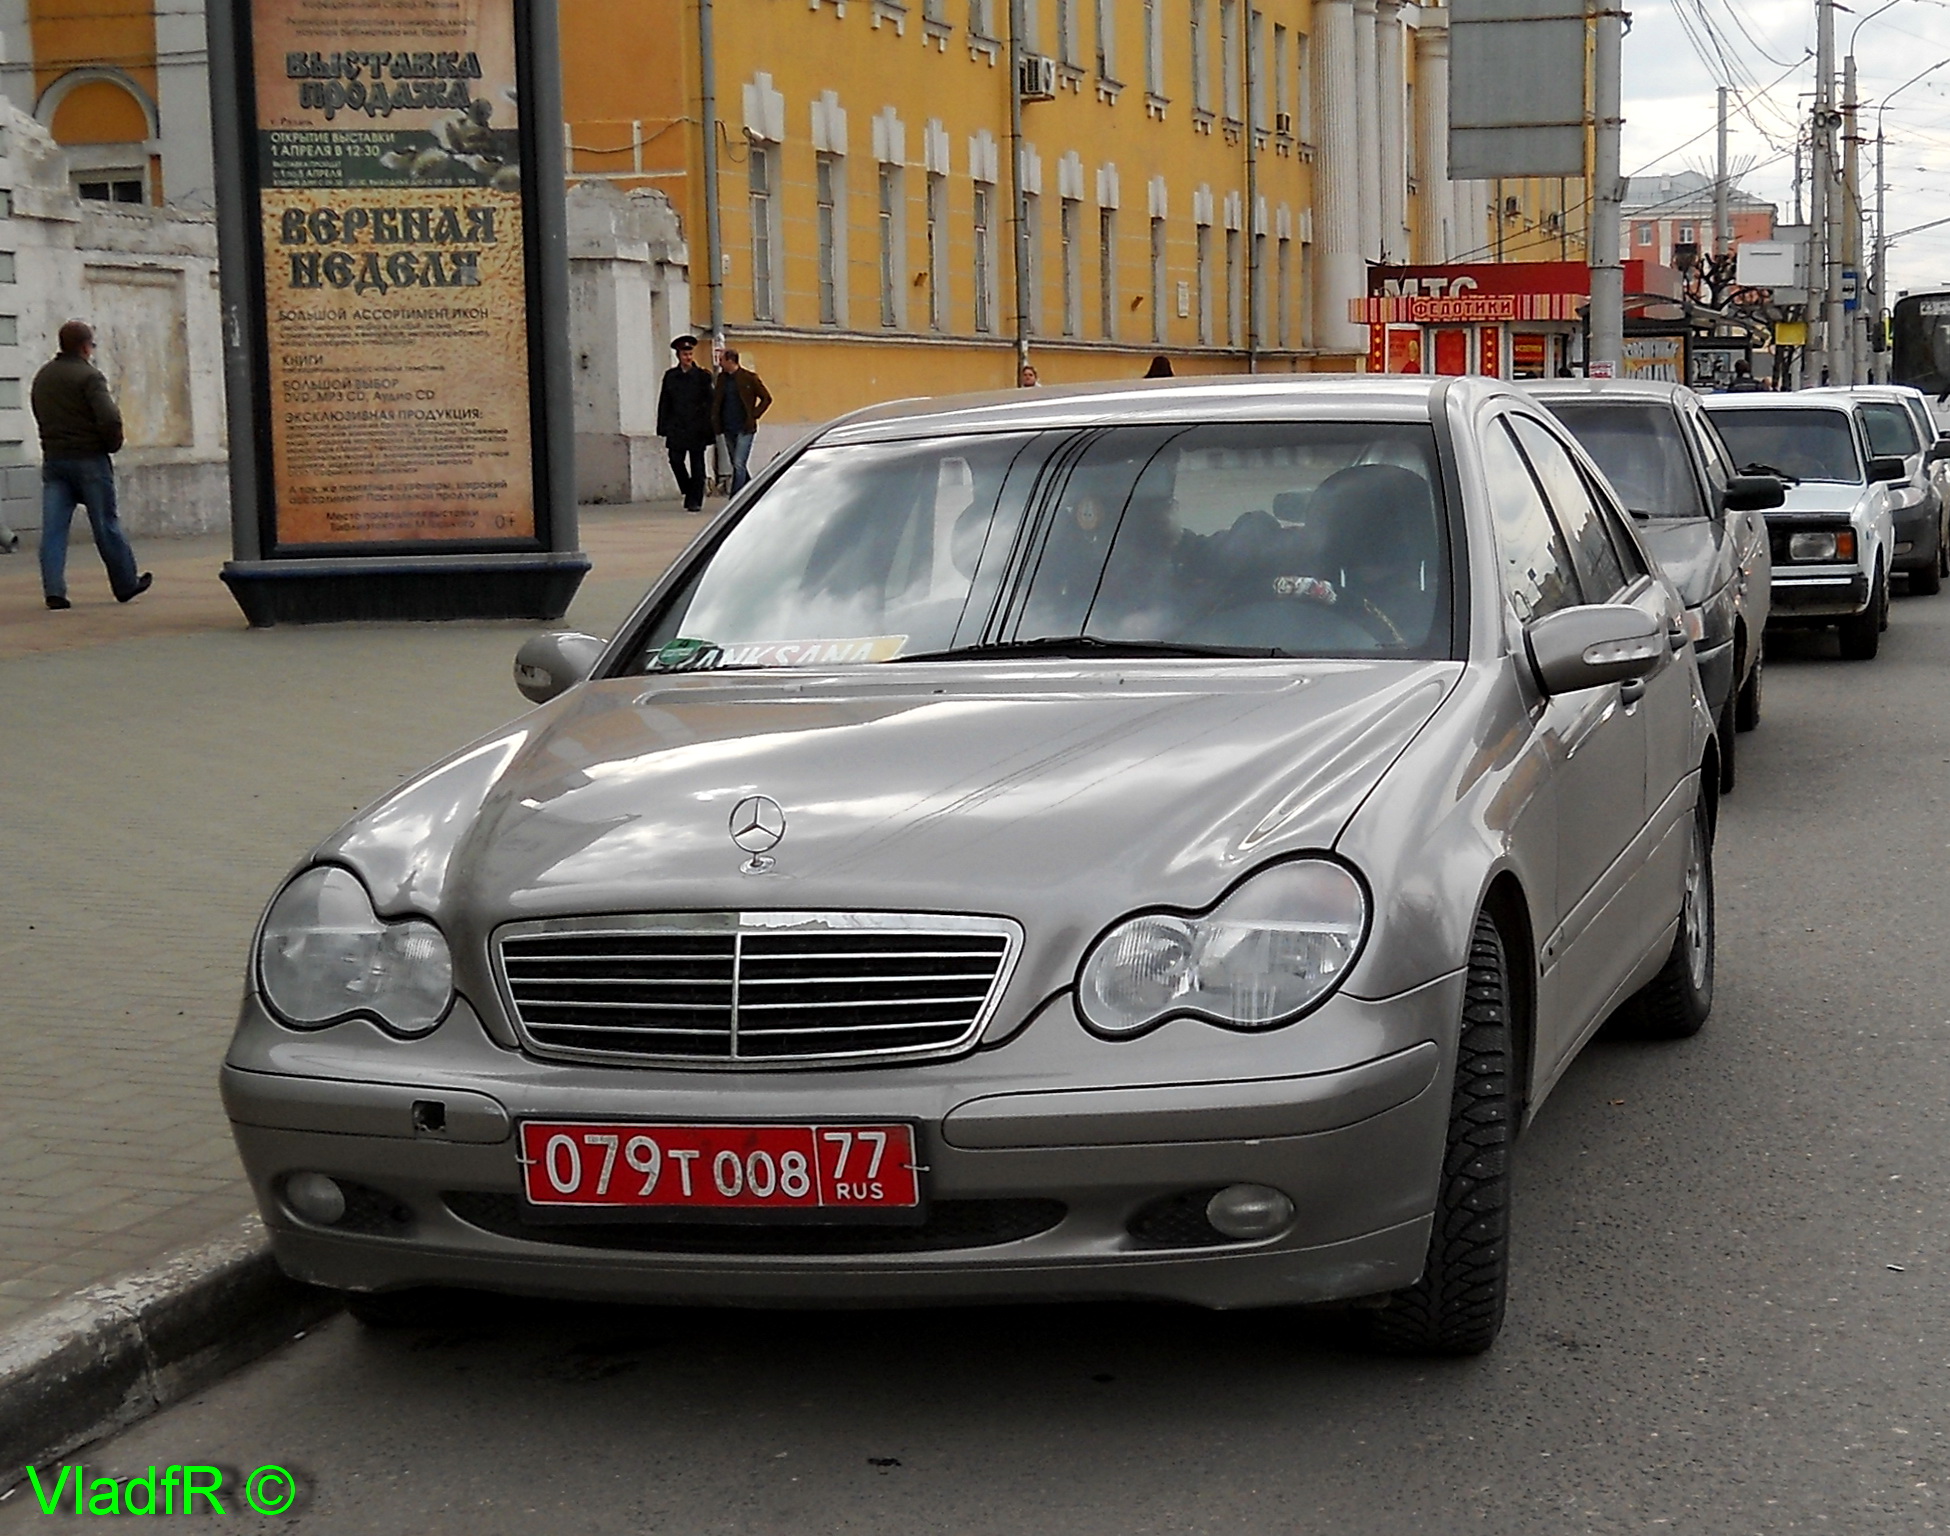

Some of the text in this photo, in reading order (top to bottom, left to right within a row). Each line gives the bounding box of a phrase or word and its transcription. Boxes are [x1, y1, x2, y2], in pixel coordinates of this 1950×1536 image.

[286, 51, 482, 79] ВЫСТАВКА
[299, 80, 473, 120] ПРОДАЖА
[271, 132, 395, 143] ОТКРЫТИЕ ВЫСТАВКИ
[271, 145, 278, 156] 1
[281, 145, 332, 156] АПРЕЛЯ
[347, 145, 380, 156] 12:30
[279, 207, 498, 245] ВЕРБНАЯ
[288, 251, 482, 295] НЕДЕЛЯ
[278, 307, 489, 321] БОЛЬШОЙ АССОРТИМЕНТ ИКОН
[1413, 301, 1512, 317] ФЕДОТИКИ
[282, 355, 323, 367] КНИГИ
[283, 378, 400, 391] БОЛЬШОЙ ВЫБОР
[415, 389, 435, 400] CD
[285, 408, 483, 423] ЭКСКЛЮЗИВНАЯ ПРОДУКЦИЯ:
[823, 1132, 887, 1179] 77
[836, 1183, 884, 1200] RUS
